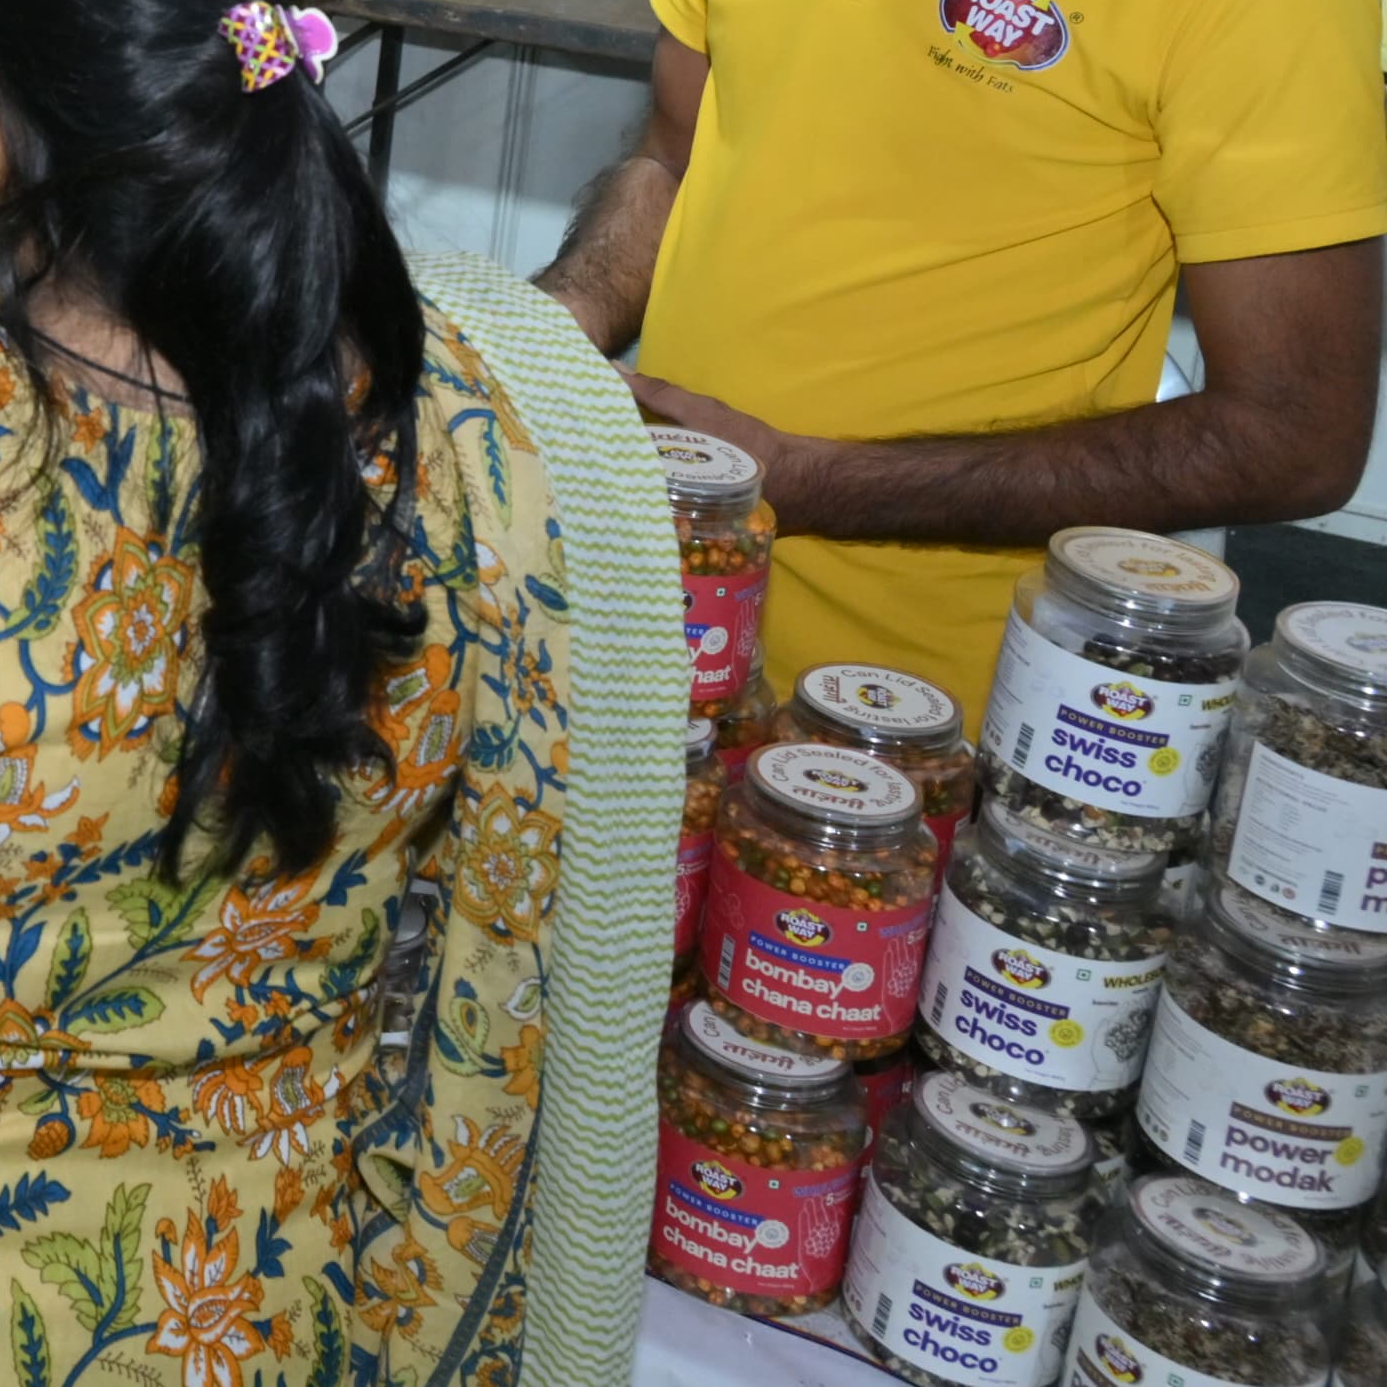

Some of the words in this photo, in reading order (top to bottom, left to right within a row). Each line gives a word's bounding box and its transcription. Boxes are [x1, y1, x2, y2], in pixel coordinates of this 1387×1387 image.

[966, 5, 1023, 47] WAY
[955, 63, 985, 83] with
[690, 665, 732, 685] haat
[840, 668, 879, 679] Can
[885, 672, 917, 688] Lid
[1098, 685, 1148, 706] ROAST
[1105, 697, 1135, 713] WAY
[1061, 709, 1105, 732] POWER
[1108, 722, 1167, 746] BOOSTER
[772, 760, 789, 782] Can
[797, 748, 870, 768] Sealed
[869, 764, 894, 781] for
[1051, 727, 1138, 770] swiss
[1044, 754, 1142, 798] choco
[780, 911, 825, 932] ROAST
[787, 923, 816, 939] WAY
[750, 934, 787, 956] POWER
[791, 951, 845, 972] BOOSTER
[998, 952, 1043, 975] ROAST
[744, 947, 845, 1000] bombay
[1005, 964, 1034, 981] WAY
[742, 976, 813, 1016] chana
[815, 1001, 883, 1022] chaat
[959, 988, 1038, 1037] swiss
[966, 969, 1005, 997] POWER
[1009, 993, 1068, 1018] BOOSTER
[703, 1013, 720, 1038] Can
[954, 1014, 1046, 1066] choco
[1273, 1081, 1324, 1102] ROAST
[1224, 1125, 1333, 1166] power
[696, 1163, 738, 1189] ROAST
[702, 1176, 728, 1191] WAY
[1219, 1150, 1336, 1193] modak
[669, 1182, 703, 1209] POWER
[706, 1202, 759, 1227] BOOSTER
[665, 1194, 761, 1254] bombay
[663, 1224, 728, 1269] chana
[730, 1254, 799, 1280] chaat
[951, 1265, 997, 1288] ROAST
[908, 1301, 993, 1346] swiss
[915, 1284, 958, 1311] POWER
[961, 1303, 1021, 1327] BOOSTER
[903, 1329, 999, 1374] choco
